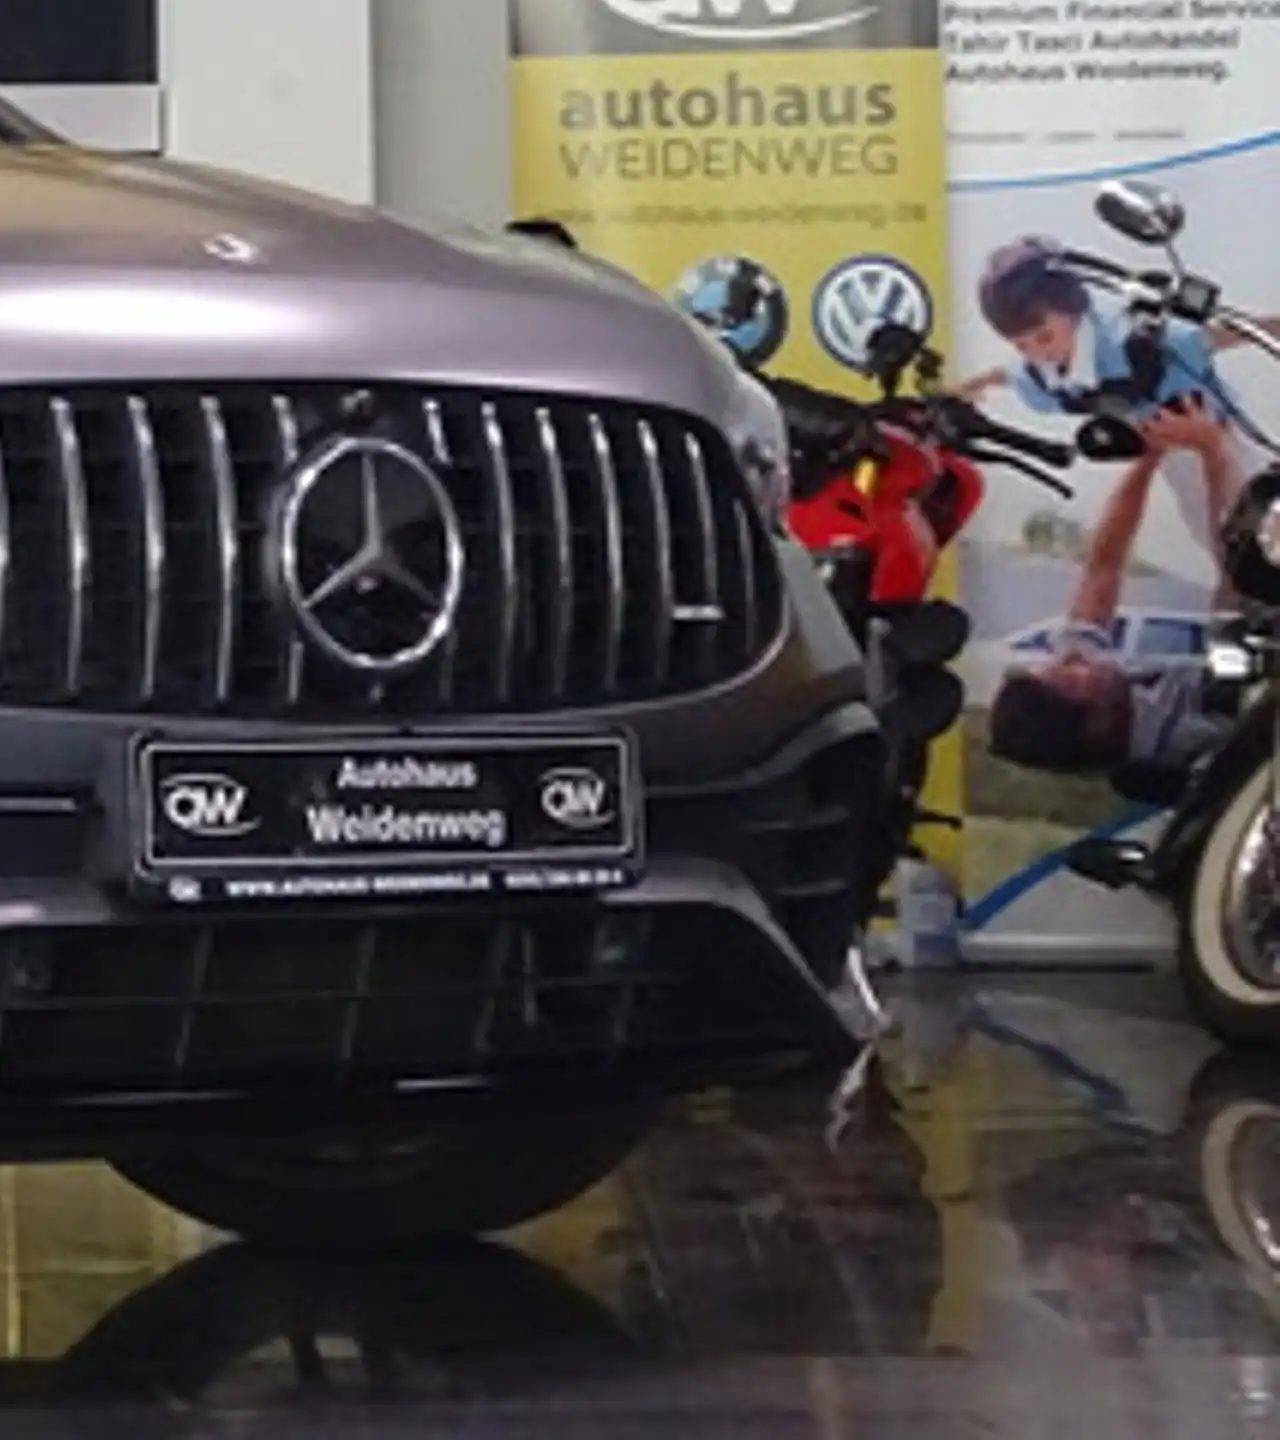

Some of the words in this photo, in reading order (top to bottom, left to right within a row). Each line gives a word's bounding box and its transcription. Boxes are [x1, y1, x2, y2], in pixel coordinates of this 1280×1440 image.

[558, 71, 898, 130] autohaus
[558, 133, 900, 181] WEIDENWEG
[339, 759, 477, 789] Autohaus
[306, 803, 507, 847] Weidenweg
